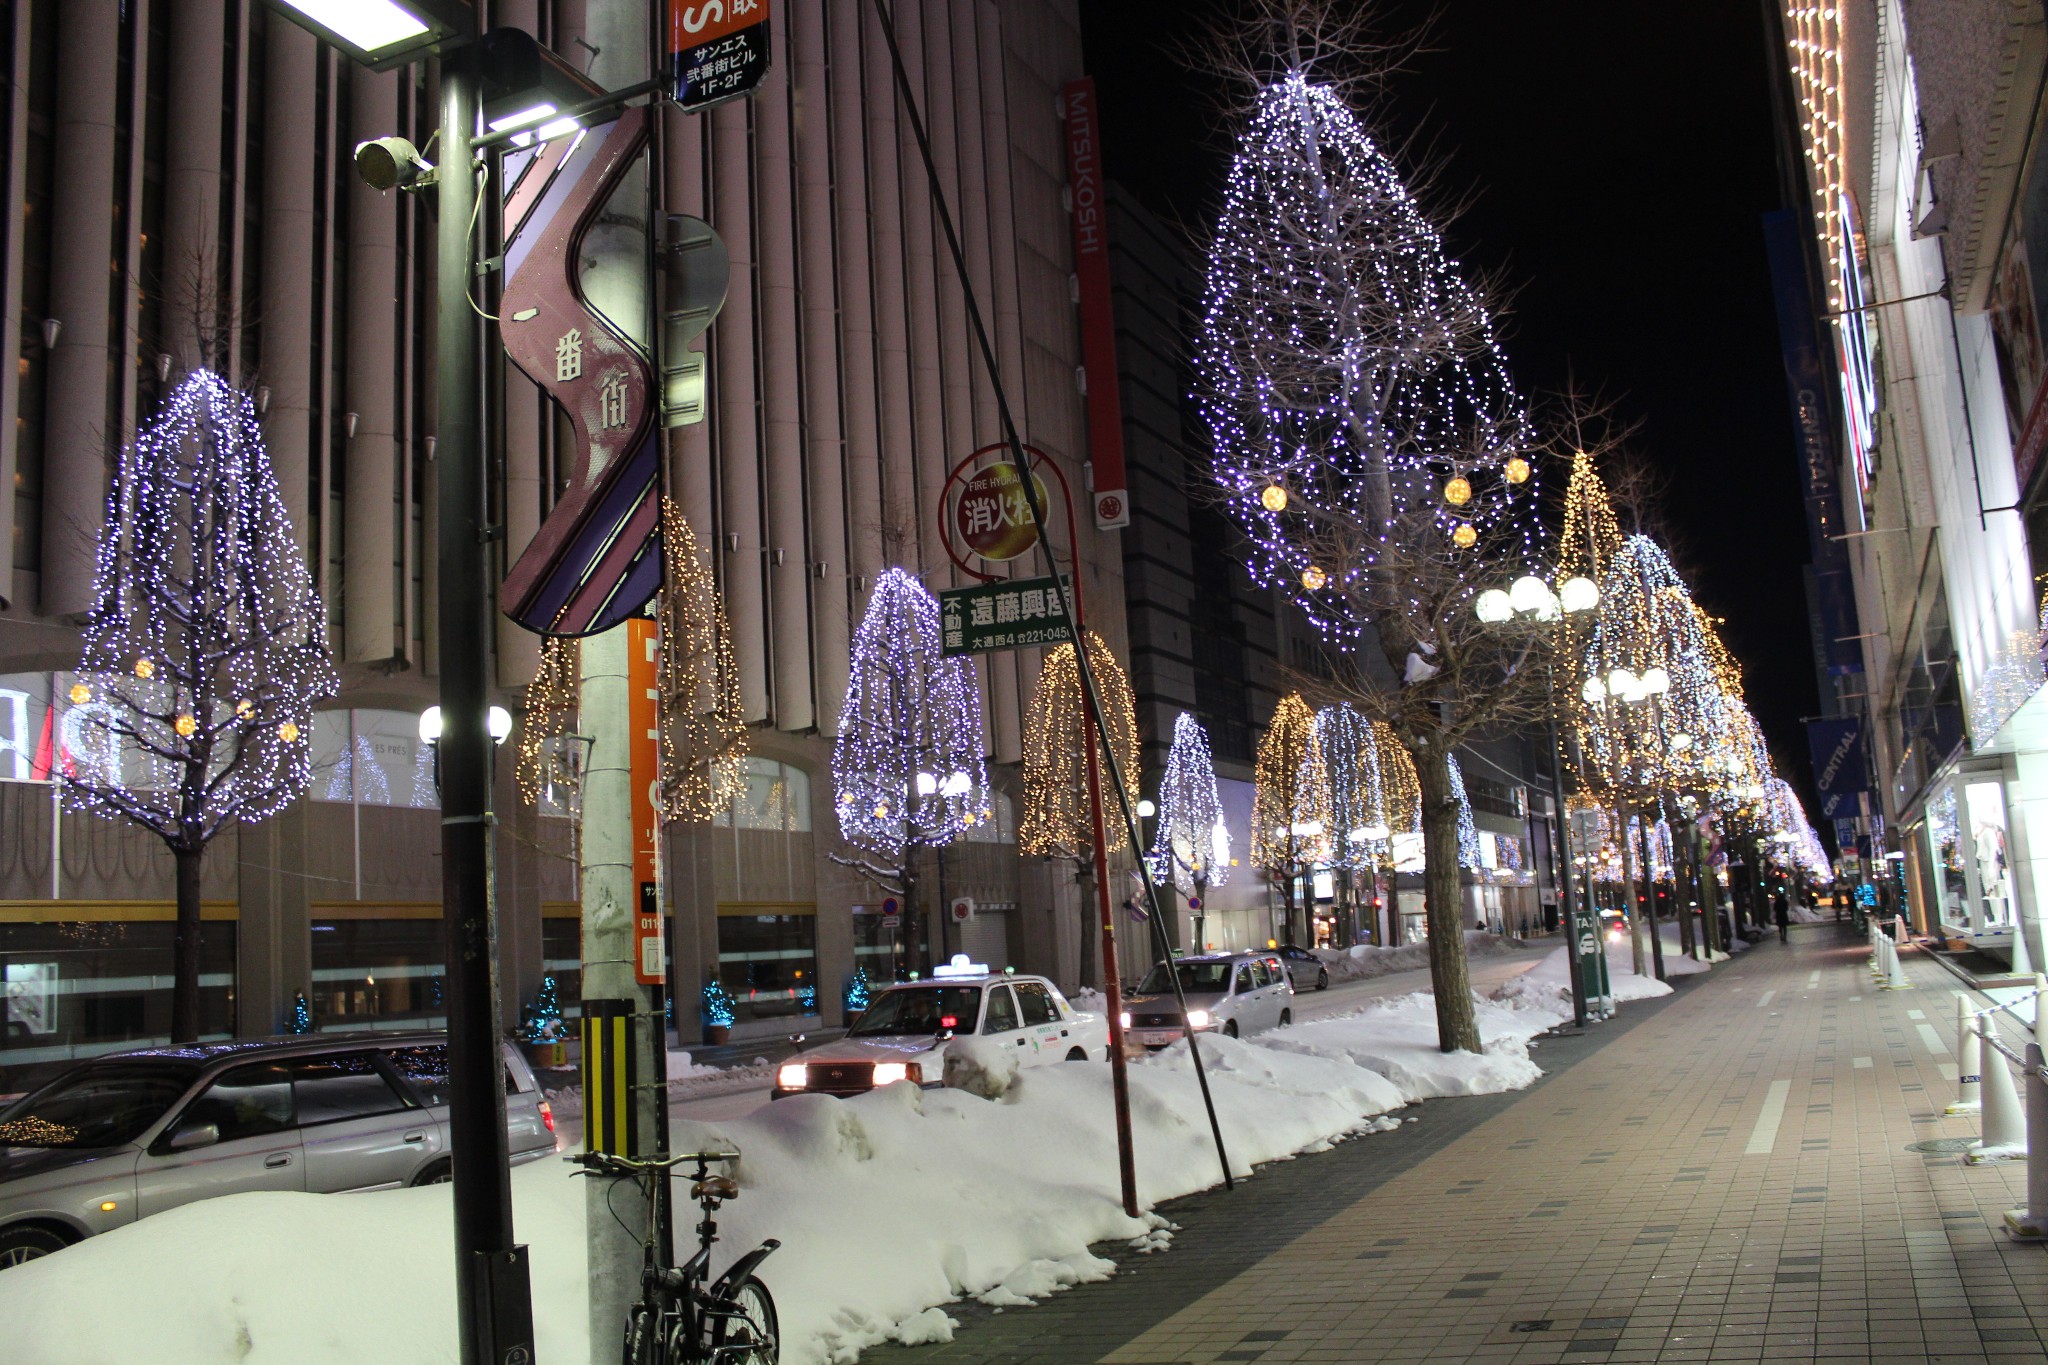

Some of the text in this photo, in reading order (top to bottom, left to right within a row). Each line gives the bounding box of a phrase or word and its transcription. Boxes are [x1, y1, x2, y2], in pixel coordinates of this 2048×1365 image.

[686, 49, 756, 84] 弐番街ビル
[694, 35, 748, 62] サンエス
[1070, 91, 1099, 254] MITSUKOSHI
[969, 473, 1021, 492] FIRE HYDRA
[964, 490, 1037, 535] 消火栓
[943, 596, 964, 648] 不動産
[1026, 626, 1071, 643] 221-045
[1818, 731, 1857, 791] CENTRAL
